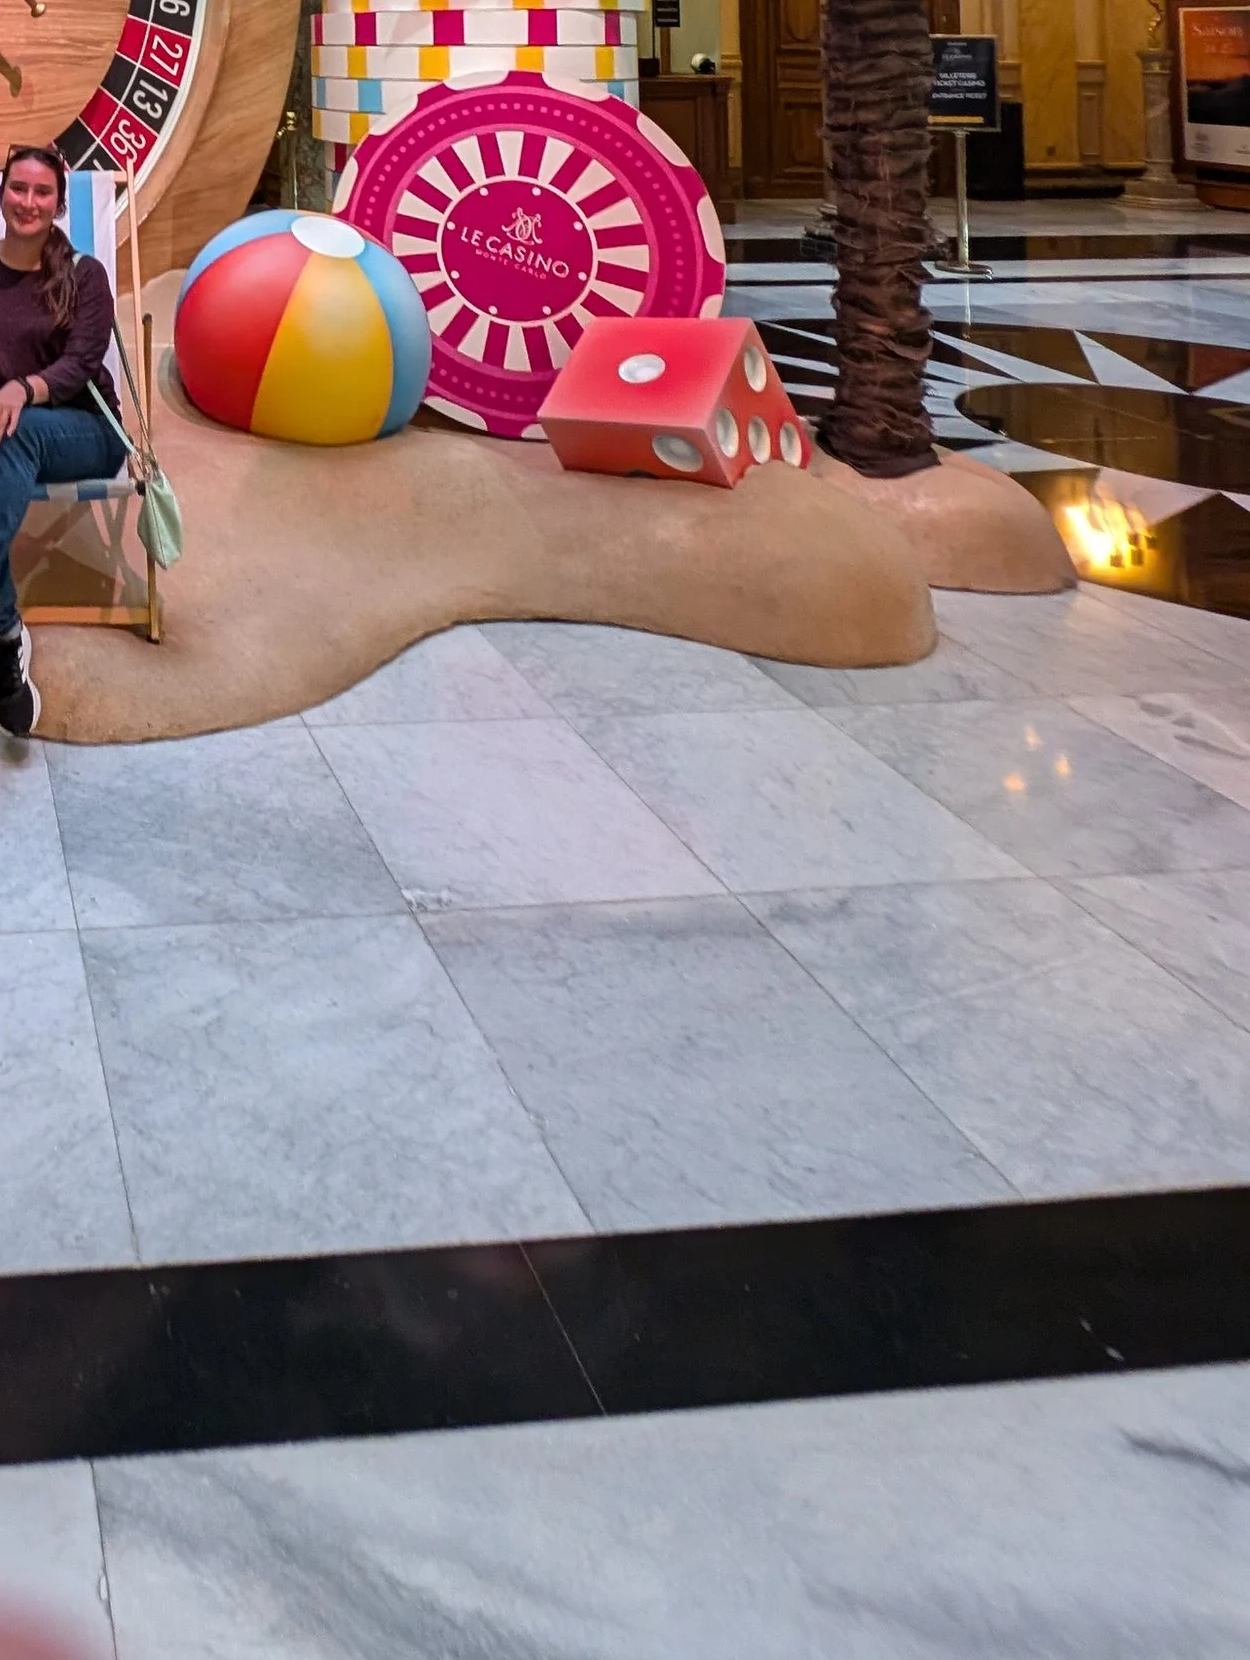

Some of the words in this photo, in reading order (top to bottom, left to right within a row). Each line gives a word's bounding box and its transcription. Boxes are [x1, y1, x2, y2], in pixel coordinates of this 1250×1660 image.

[150, 34, 183, 78] 27
[132, 80, 169, 120] 13
[110, 119, 146, 163] 36
[460, 226, 484, 247] LE
[485, 235, 570, 279] CASINO
